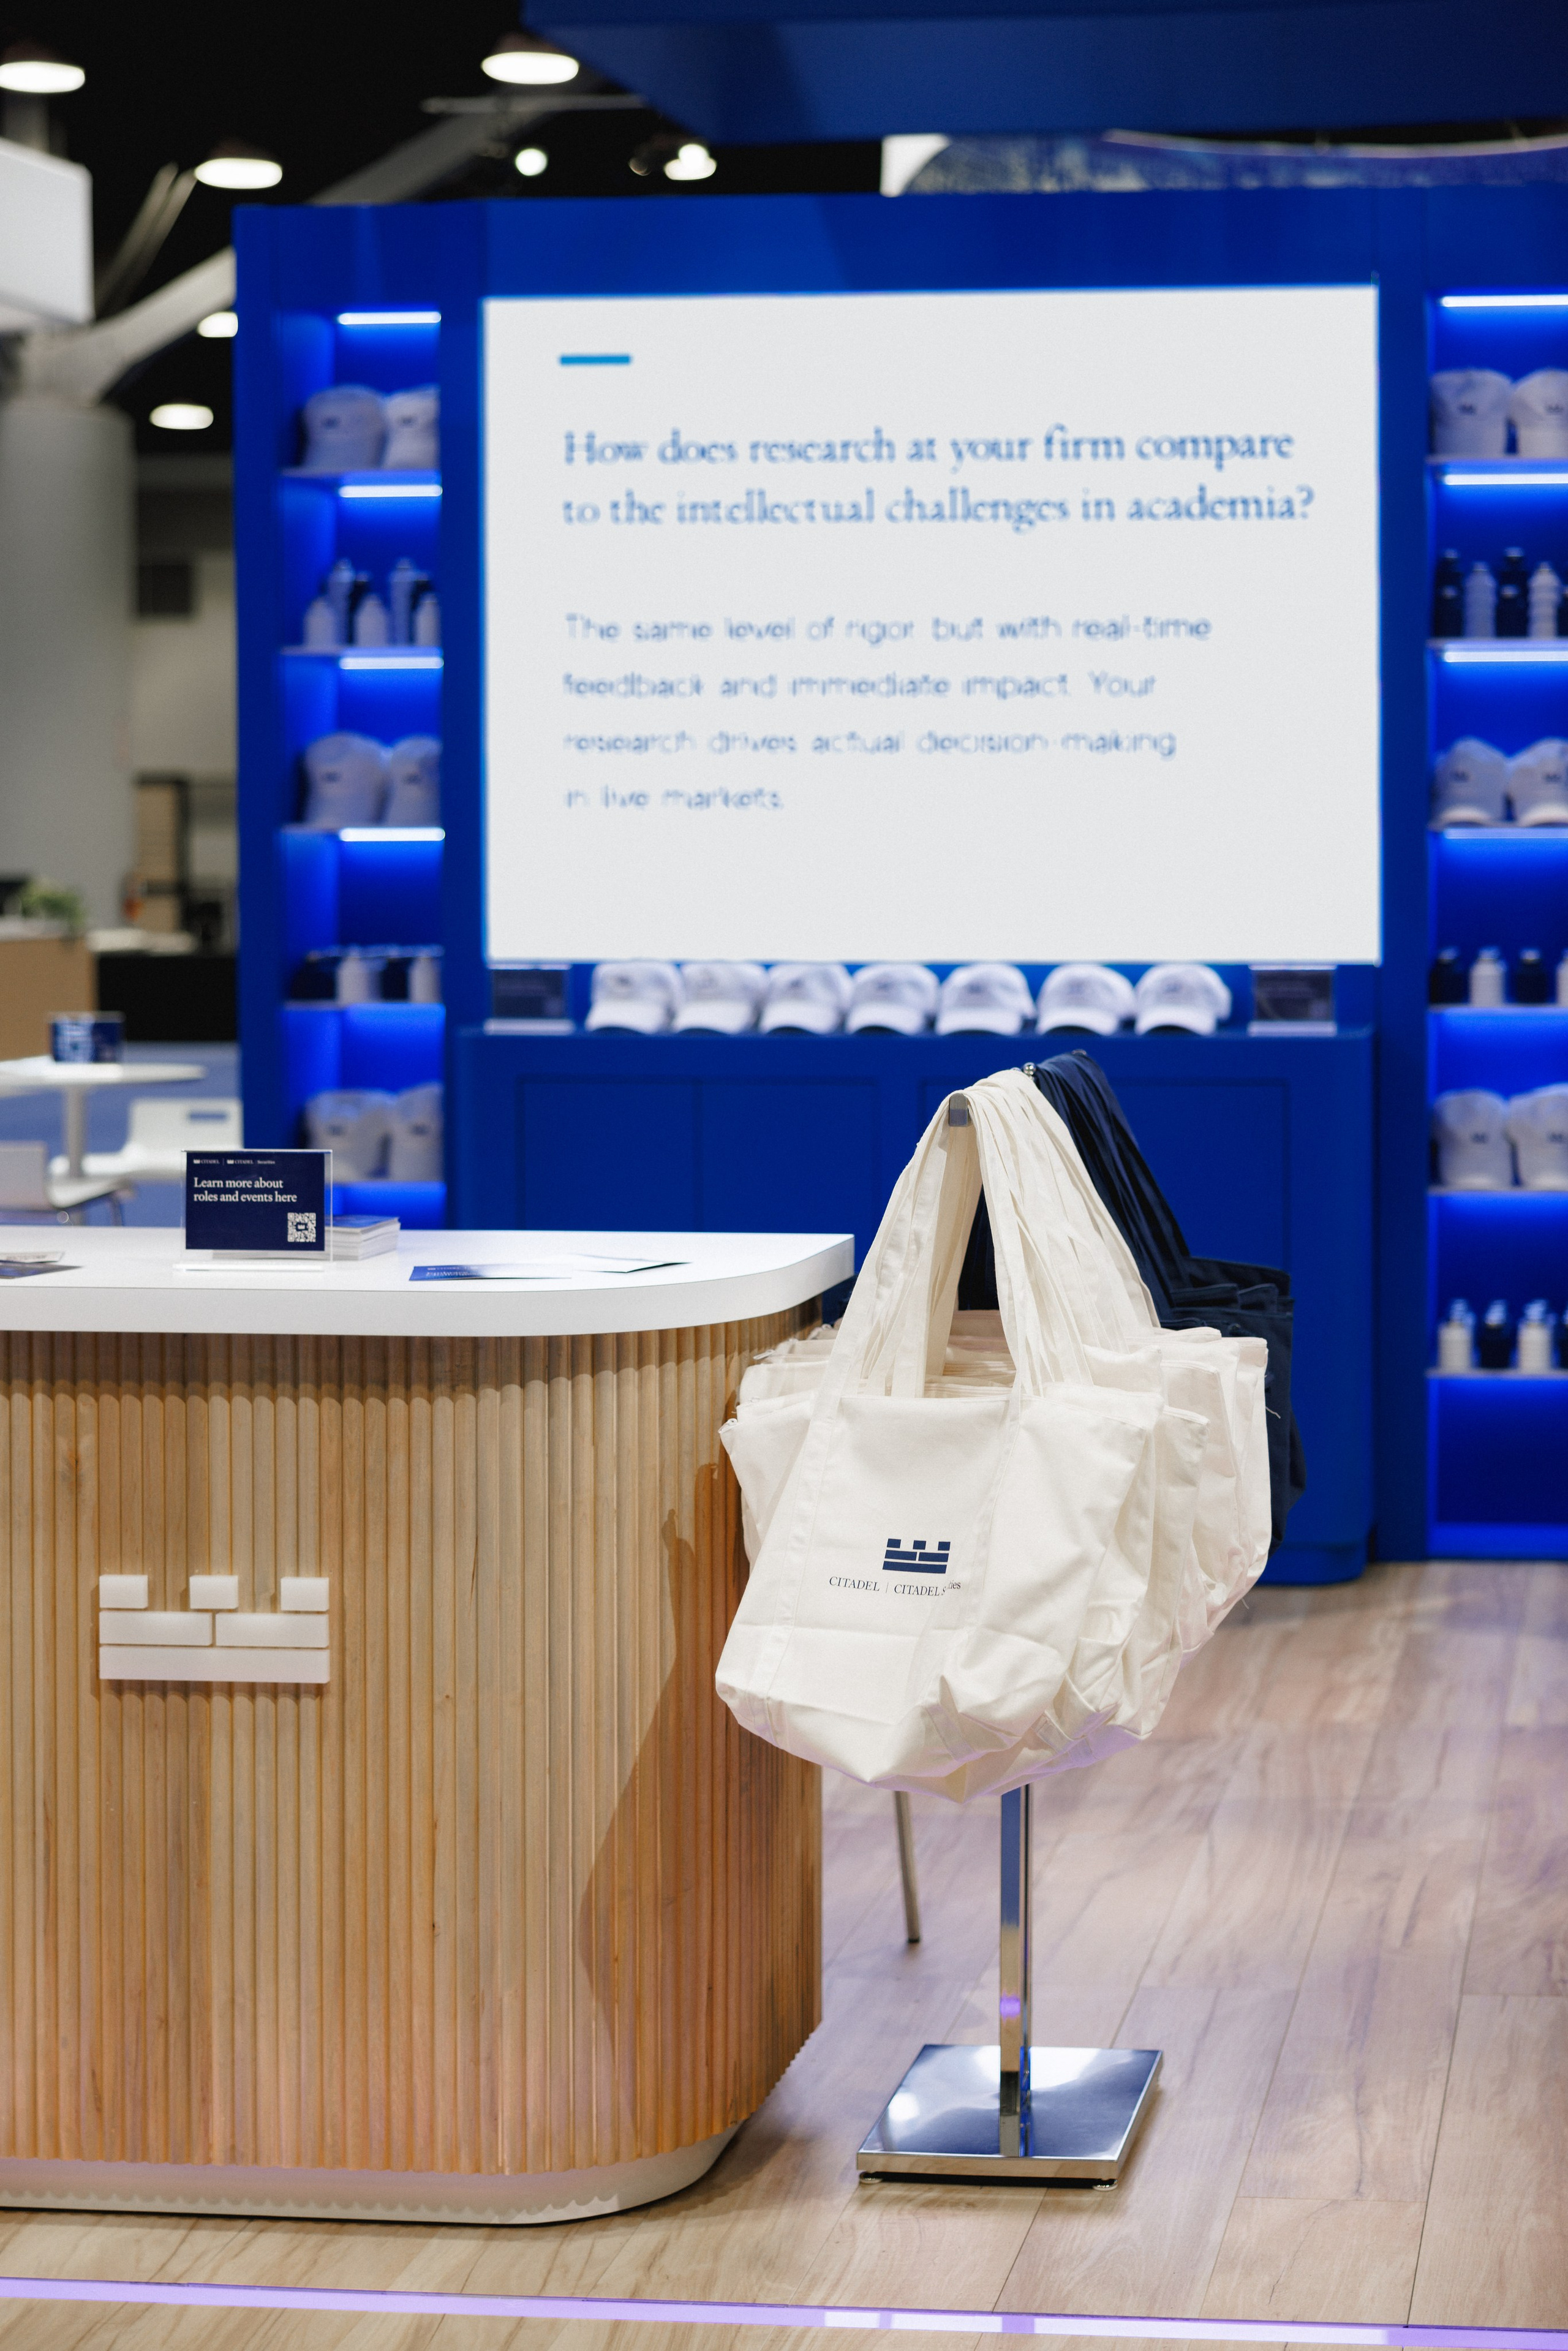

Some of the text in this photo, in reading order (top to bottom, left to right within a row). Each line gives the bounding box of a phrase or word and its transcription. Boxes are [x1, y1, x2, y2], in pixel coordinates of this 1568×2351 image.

[563, 421, 1296, 474] How does research at your firm compare
[561, 481, 1316, 535] to the intellectual challenges in academia?
[564, 611, 1215, 649] The same level of rigor but with real-time
[561, 670, 706, 700] feedback
[718, 671, 778, 700] and
[787, 670, 952, 700] immediate
[1087, 670, 1158, 700] Your
[562, 729, 696, 756] research
[707, 729, 799, 756] drives
[810, 729, 905, 756] actual
[564, 786, 590, 811] in
[599, 783, 652, 811] live
[194, 1177, 224, 1188] Learn
[254, 1177, 284, 1188] about
[194, 1190, 298, 1202] roles and events here
[829, 1576, 880, 1591] CITADEL
[894, 1583, 940, 1596] CITADEL
